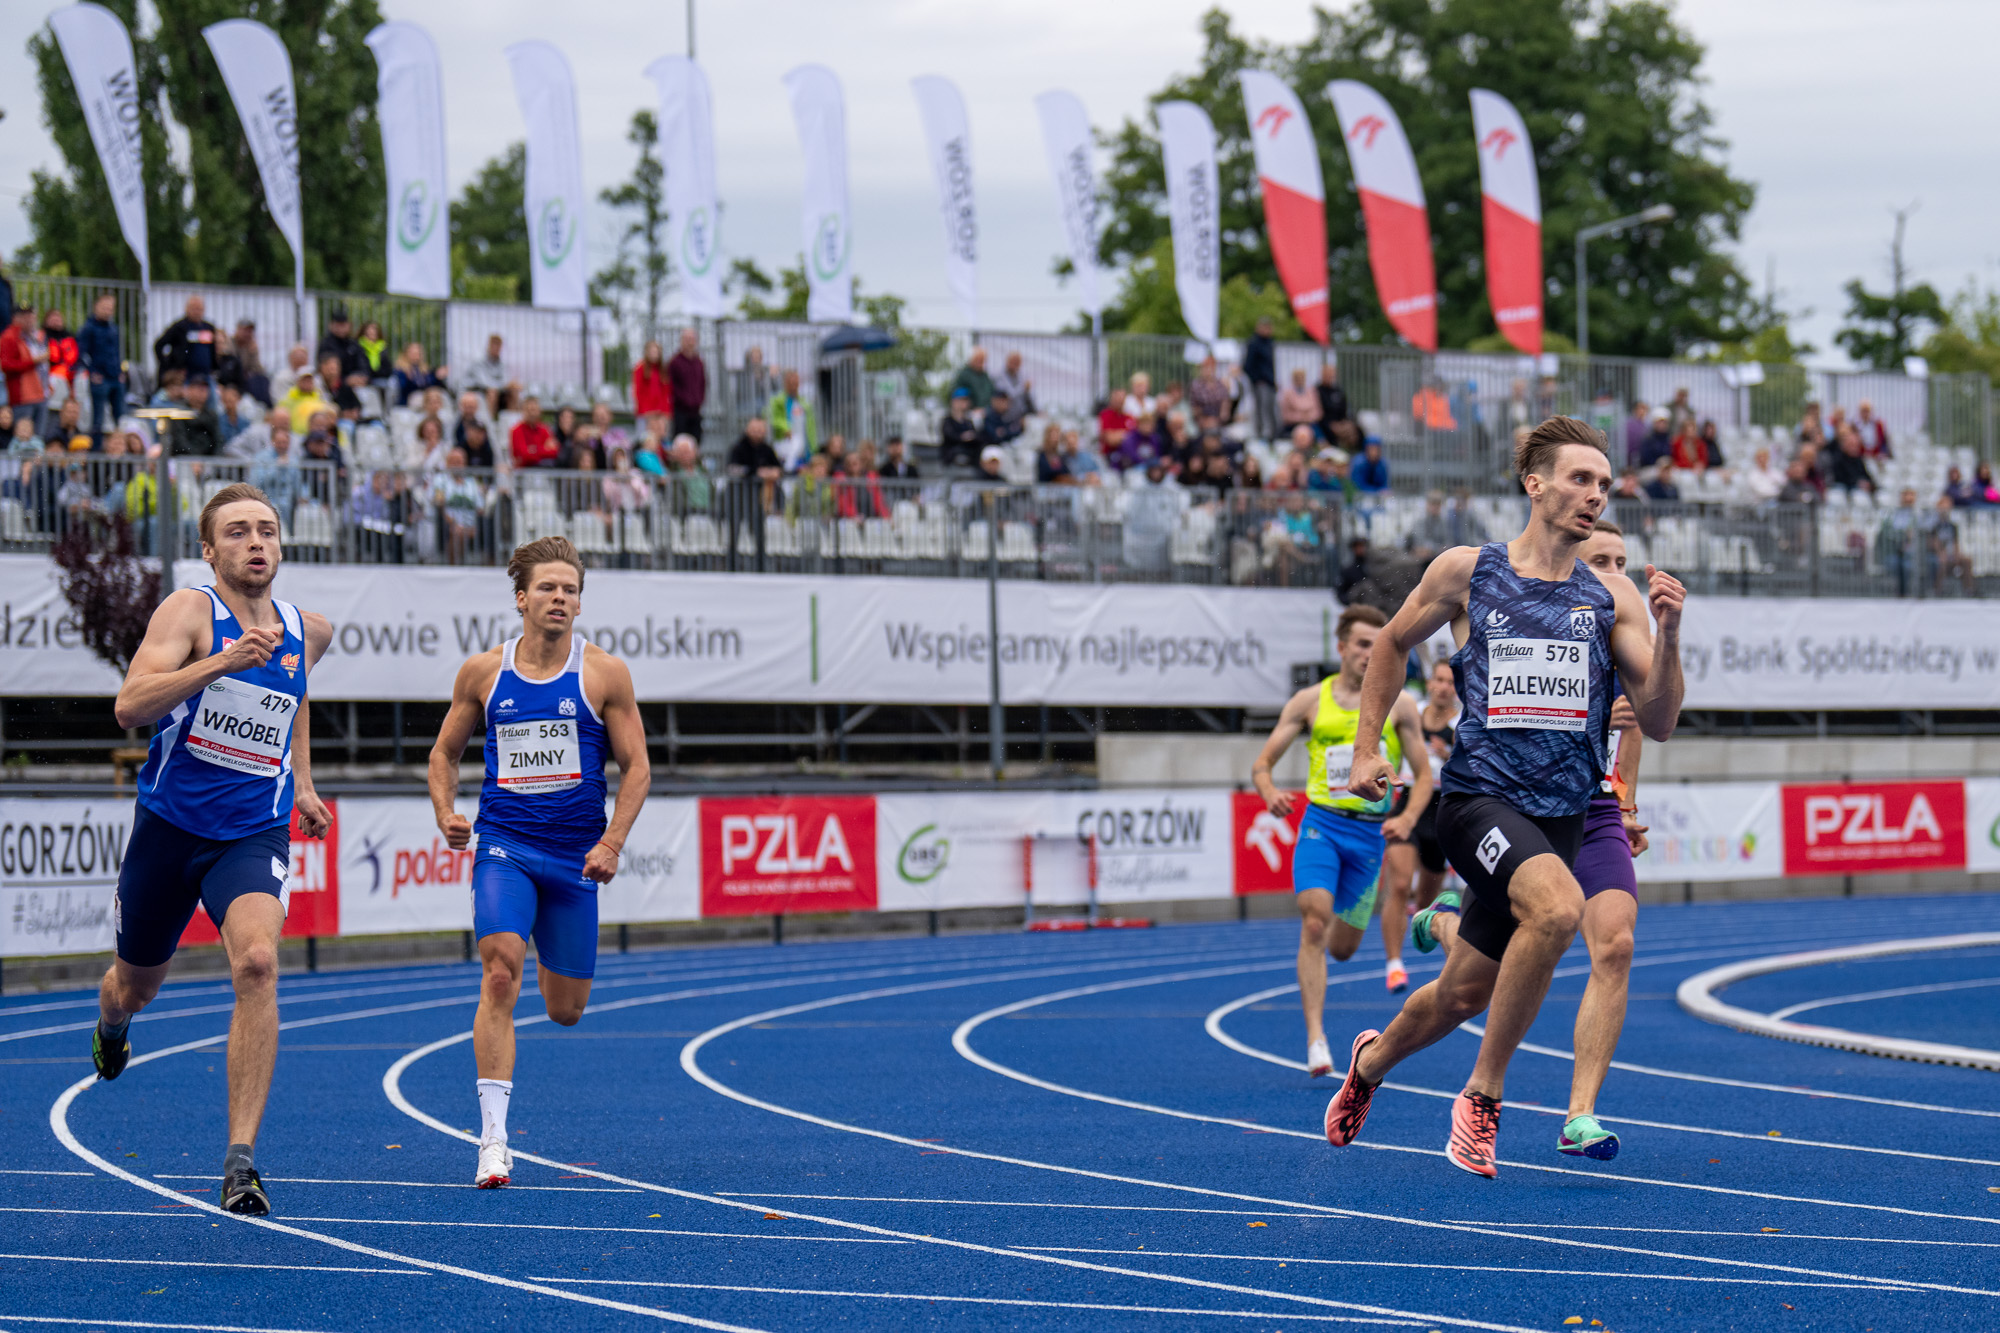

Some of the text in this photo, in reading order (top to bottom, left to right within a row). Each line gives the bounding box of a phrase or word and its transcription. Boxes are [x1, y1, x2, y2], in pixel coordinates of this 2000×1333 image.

[884, 622, 1267, 675] Wspieamy najlepszych
[1491, 643, 1580, 663] Artisan 578
[1720, 636, 1786, 673] Bank
[1797, 635, 1966, 683] Spółdzielczy
[1492, 675, 1585, 698] ZALEWSKI
[260, 694, 291, 714] 479
[203, 708, 281, 747] WRÓBEL
[498, 723, 569, 739] Artisan 563
[1521, 718, 1567, 726] WIELKOPOLSKI
[189, 746, 219, 760] GORZÓW
[220, 756, 262, 771] WIELKOPOLSKI
[210, 743, 225, 752] PZLA
[256, 755, 271, 763] Polski
[509, 749, 565, 768] ZIMNY
[1803, 792, 1943, 847] PZLA
[1, 806, 124, 875] GORZÓW
[721, 813, 854, 875] PZLA
[1481, 834, 1500, 863] 5
